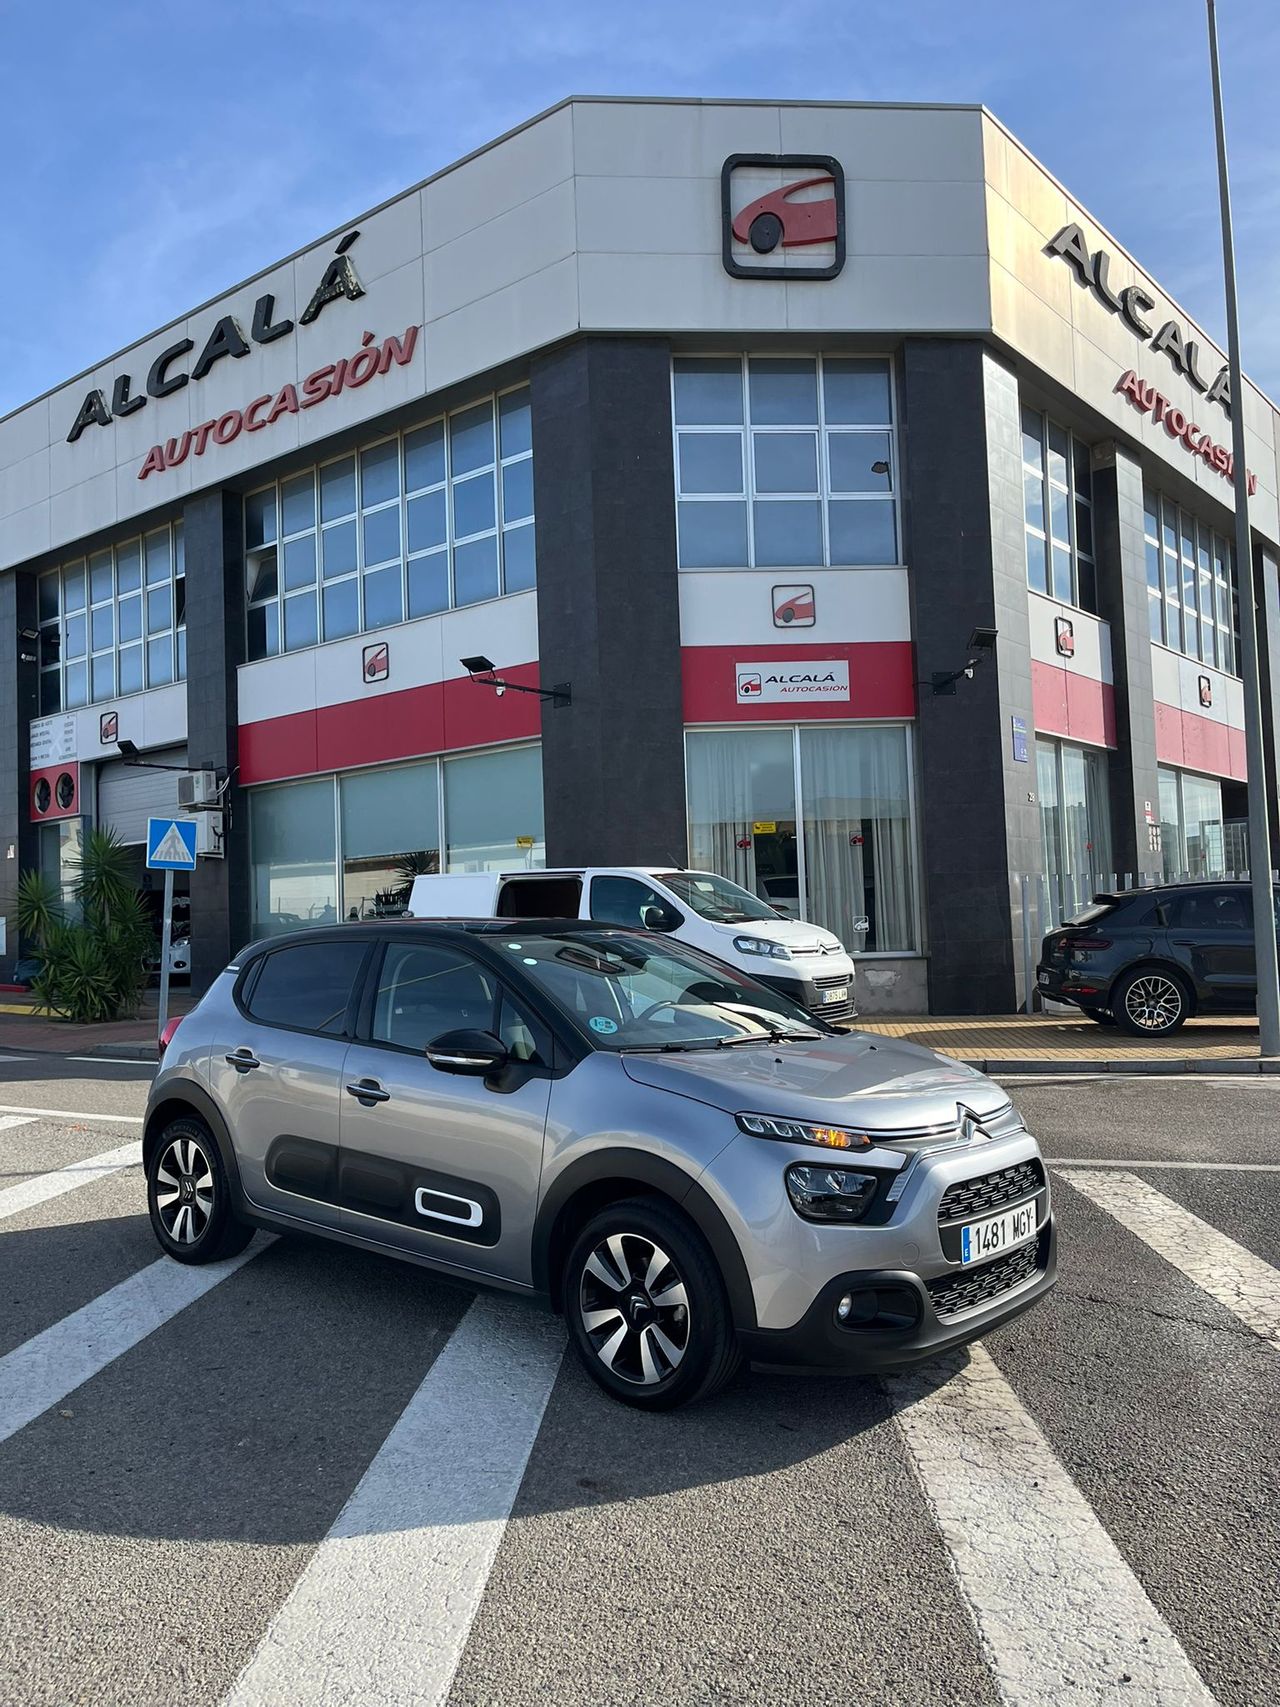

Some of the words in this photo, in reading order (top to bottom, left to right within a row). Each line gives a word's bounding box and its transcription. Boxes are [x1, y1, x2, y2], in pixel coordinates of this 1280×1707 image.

[66, 230, 367, 443] ALCALÁ
[137, 325, 421, 480] AUTOCASIÓN
[1112, 369, 1258, 497] AUTOCASIN
[765, 672, 835, 683] ALCALÁ
[975, 1218, 1006, 1255] 1481
[1012, 1207, 1032, 1241] MGY
